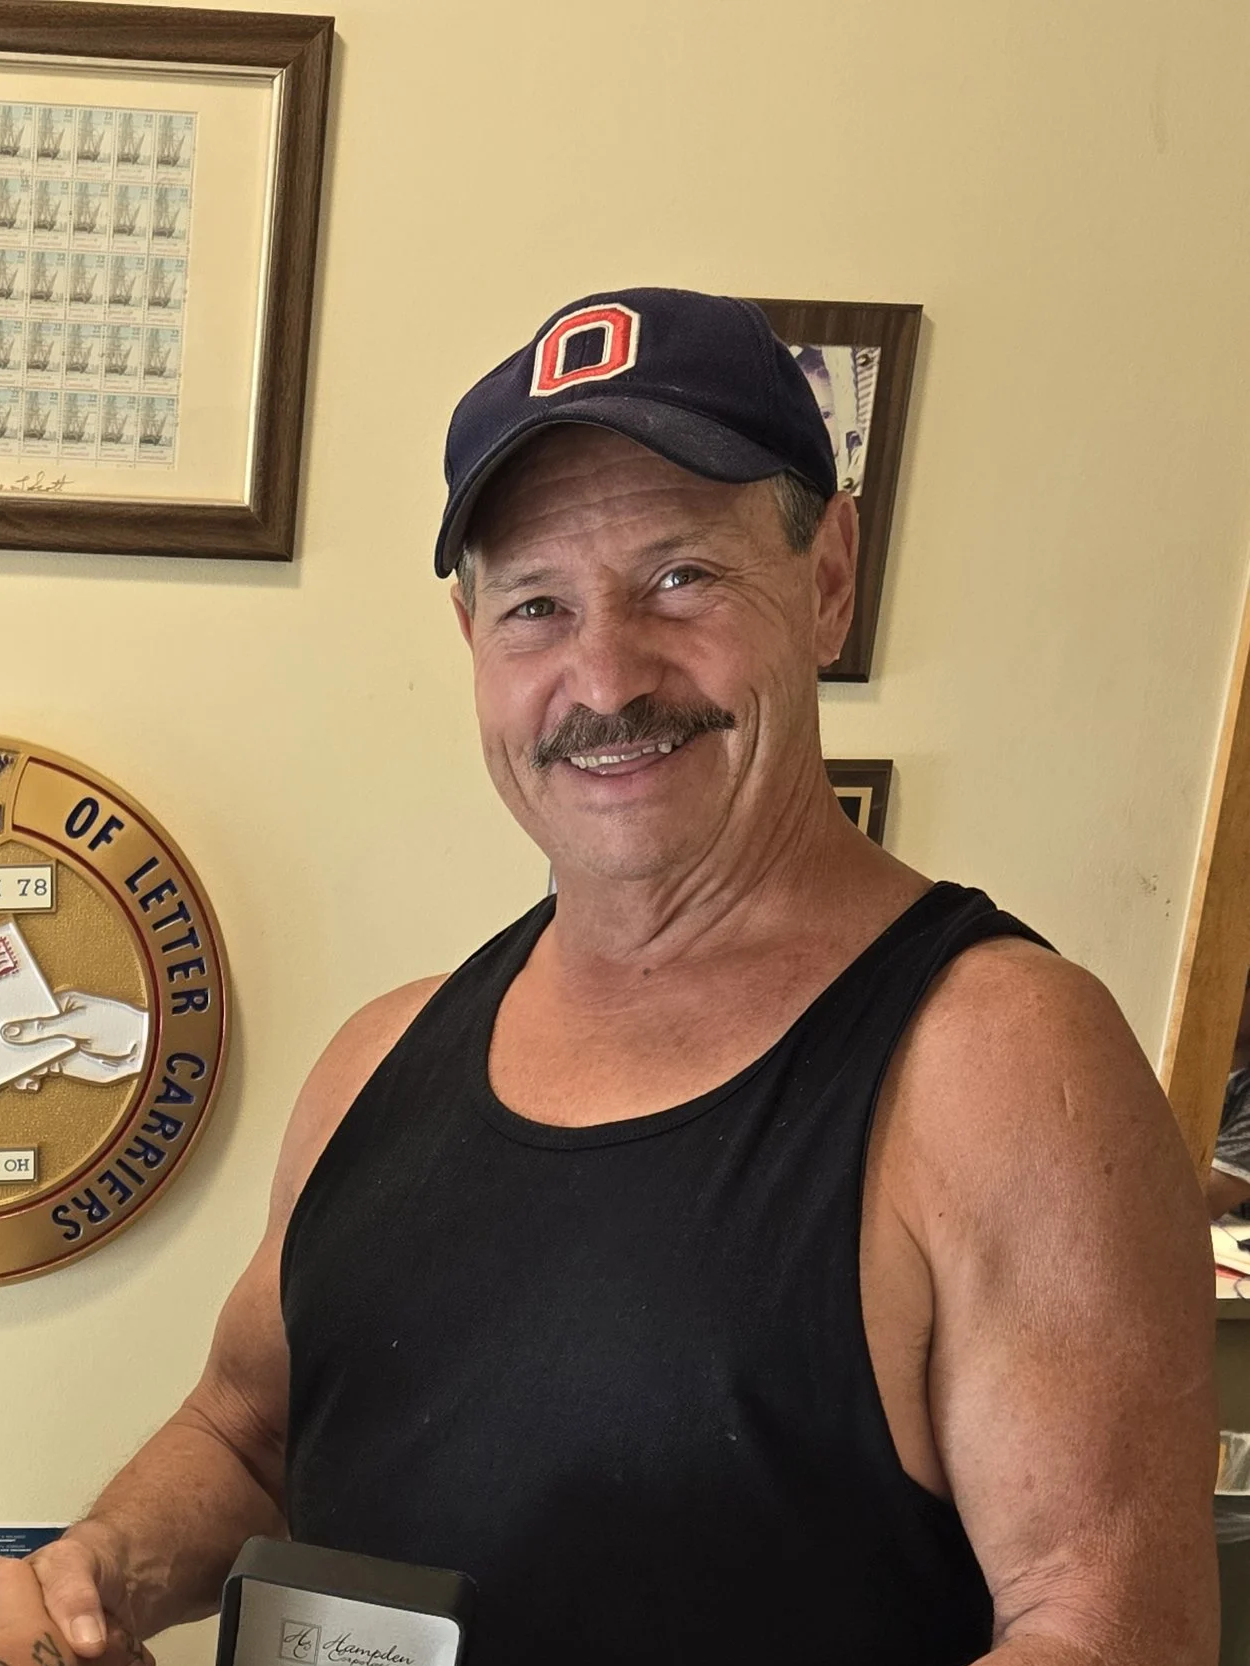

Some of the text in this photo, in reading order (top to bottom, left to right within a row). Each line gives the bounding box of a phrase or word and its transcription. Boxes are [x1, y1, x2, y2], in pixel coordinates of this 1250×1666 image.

[529, 302, 641, 397] O
[64, 796, 125, 852] OF
[17, 878, 48, 897] 78
[123, 856, 212, 1016] LETTER
[4, 1159, 30, 1172] OH
[52, 1052, 207, 1241] CARRIERS
[322, 1632, 415, 1665] Hampden
